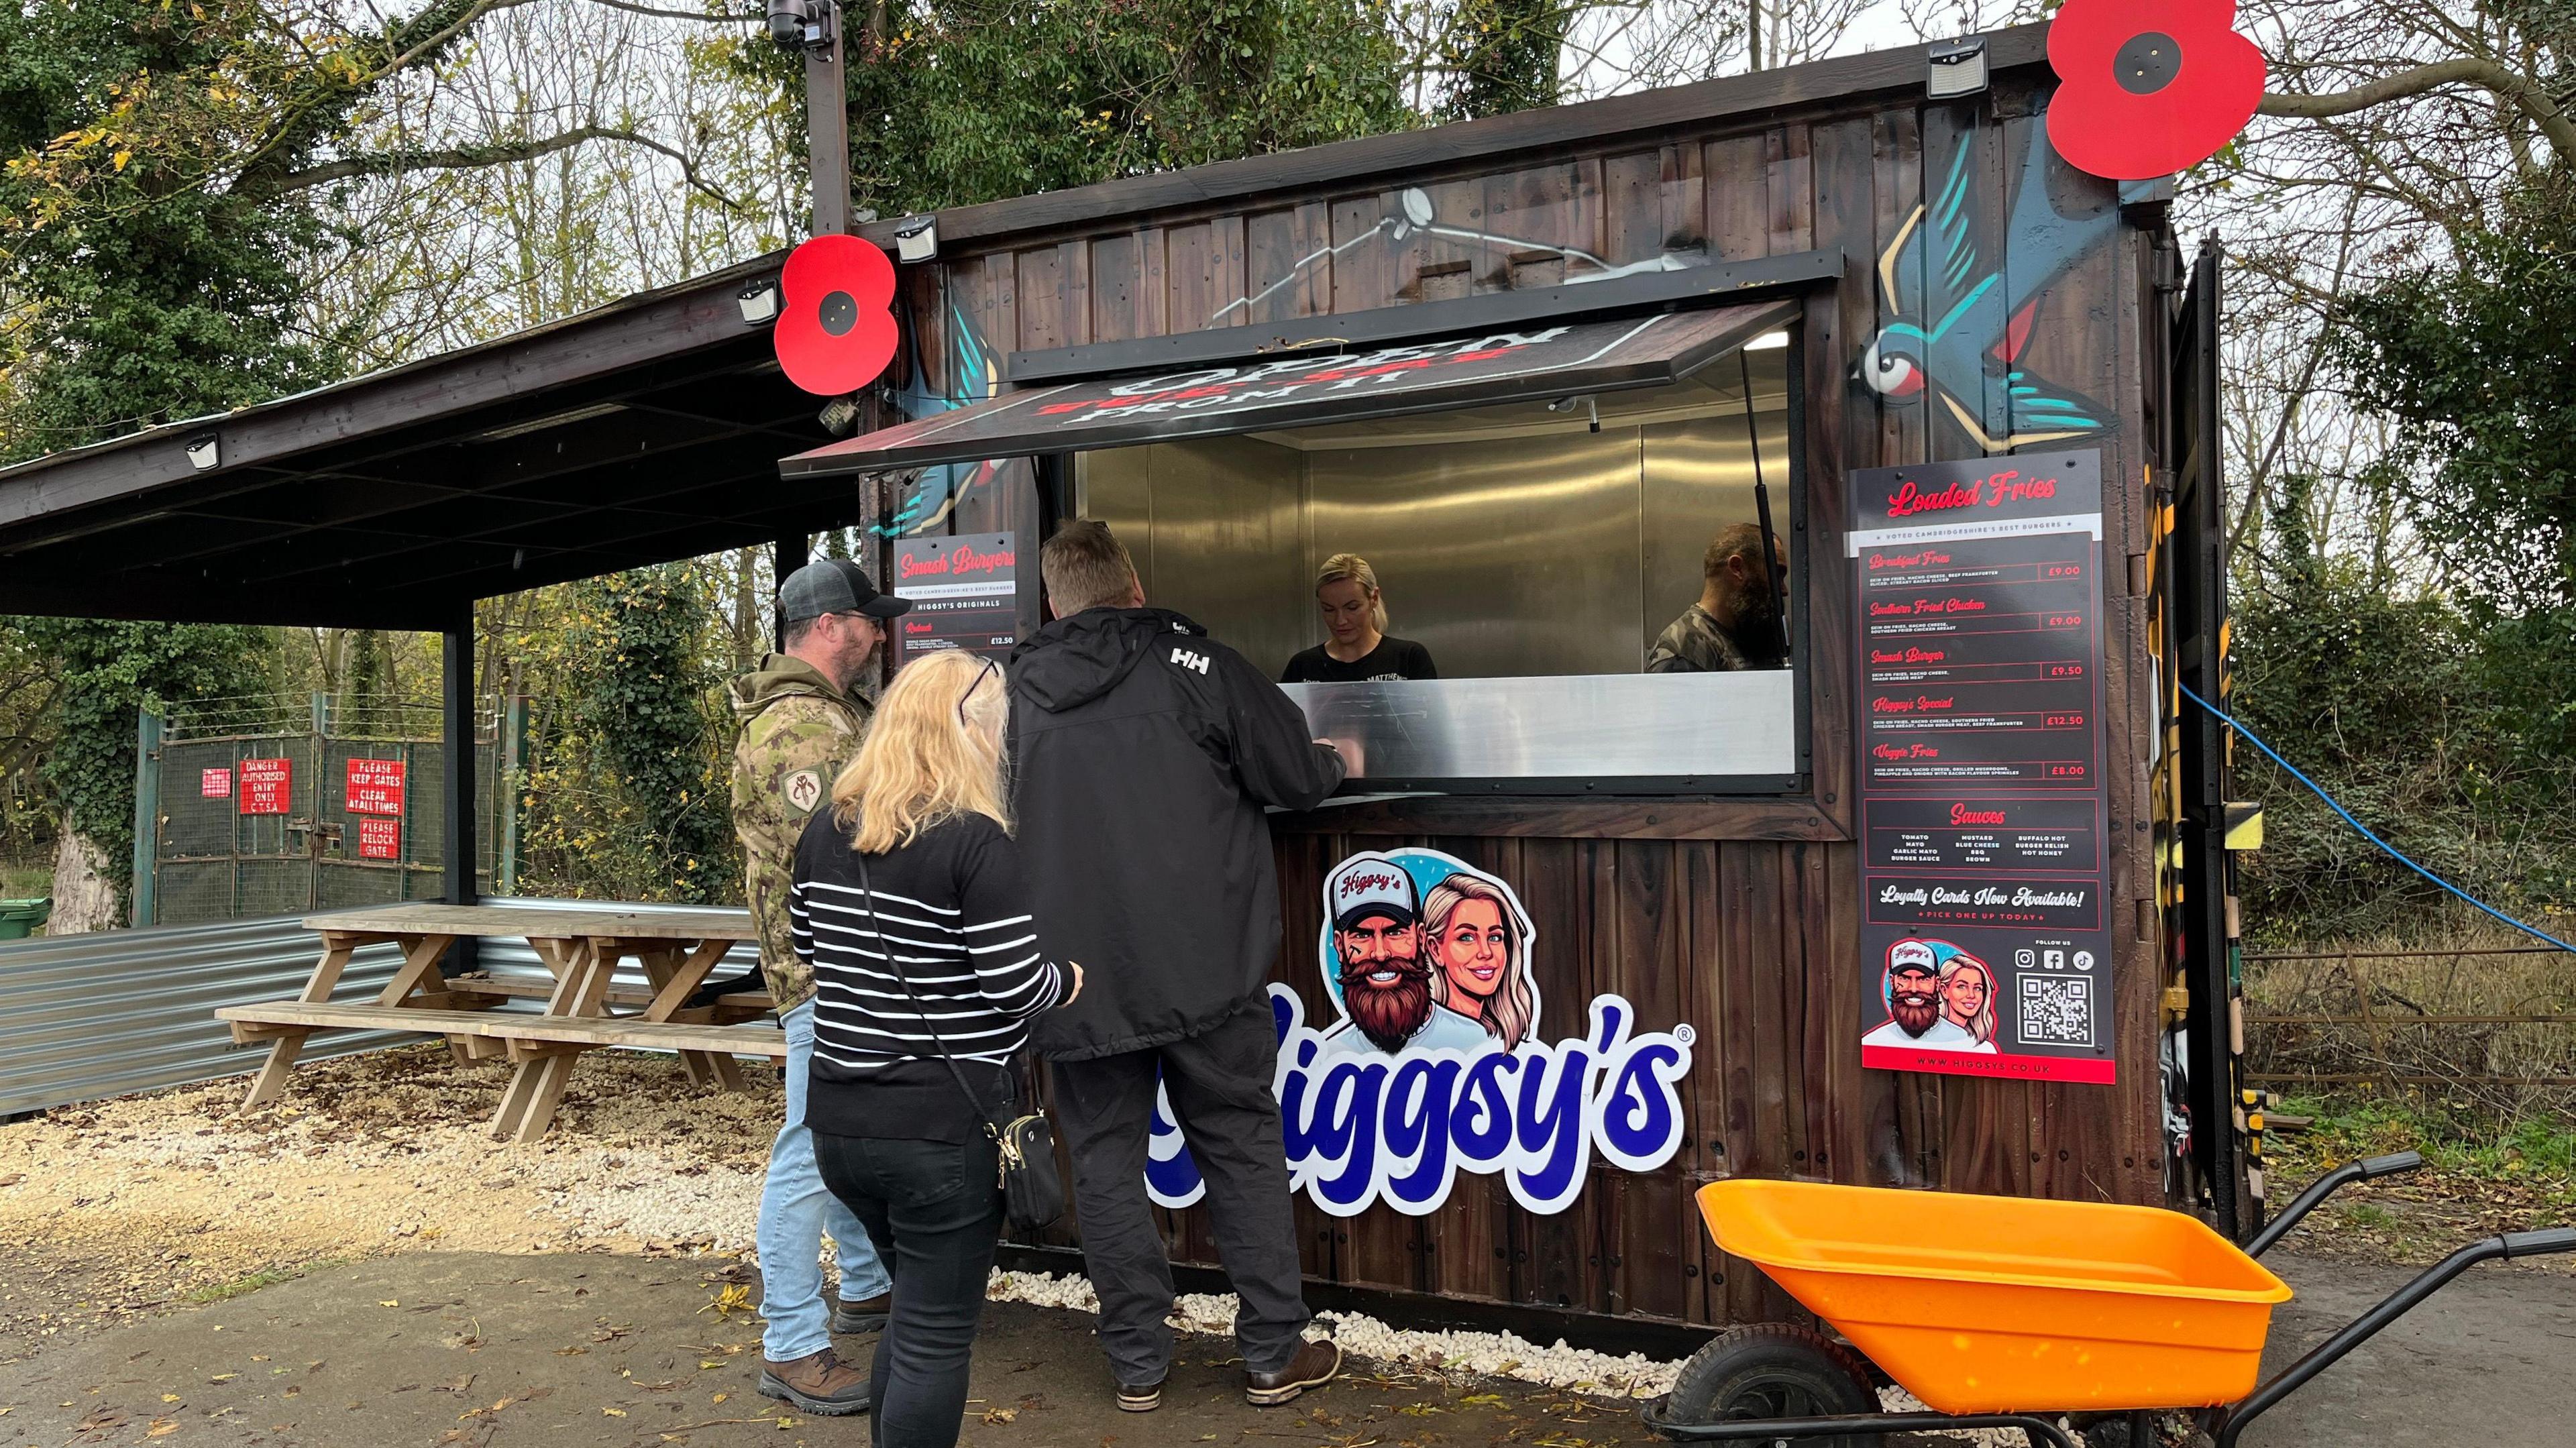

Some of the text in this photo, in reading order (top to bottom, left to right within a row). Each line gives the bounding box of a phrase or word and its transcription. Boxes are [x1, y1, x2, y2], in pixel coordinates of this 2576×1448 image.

[1108, 326, 1574, 396] OPEN
[1063, 384, 1311, 424] FROM
[1888, 469, 2057, 518] Loaded Fries
[1916, 525, 1996, 538] CAMBRIDGESHIRE'S
[2023, 522, 2061, 531] BURGERS
[901, 544, 1016, 579] Smash Burgers
[1922, 550, 1951, 566] Fries
[2049, 566, 2080, 576] £9.00
[918, 600, 1000, 611] HIGGSY'S ORIGINALS
[1870, 598, 1986, 617] Southern Fried Chicken
[2049, 616, 2082, 626] £9.00
[991, 637, 1013, 645] £12.50
[1871, 646, 1945, 664] Smash Burger
[1170, 648, 1210, 675] HH
[2051, 667, 2082, 676] £9.50
[1917, 695, 1953, 712] Special
[2047, 716, 2084, 726] £12.50
[1872, 743, 1939, 761] Veggie Fries
[246, 761, 278, 772] DANGER
[359, 762, 392, 774] PLEASE
[2051, 767, 2084, 776] £8.00
[241, 771, 286, 783] AUTHORISED
[351, 773, 400, 787] KEEP GATES
[253, 782, 276, 793] ENTRY
[255, 792, 276, 802] ONLY
[360, 789, 386, 801] CLEAR
[374, 801, 399, 813] TIMES
[1950, 802, 2006, 826] Sauces
[362, 822, 394, 834] PLEASE
[362, 833, 394, 845] RELOCK
[366, 845, 387, 856] GATE
[1340, 870, 1401, 899] Higgsy's
[1880, 885, 2085, 908] Loyalty Cards Now Available!
[2000, 913, 2036, 922] TODAY
[1895, 946, 1929, 960] Higgsy's
[1144, 994, 1678, 1205] iggsy's
